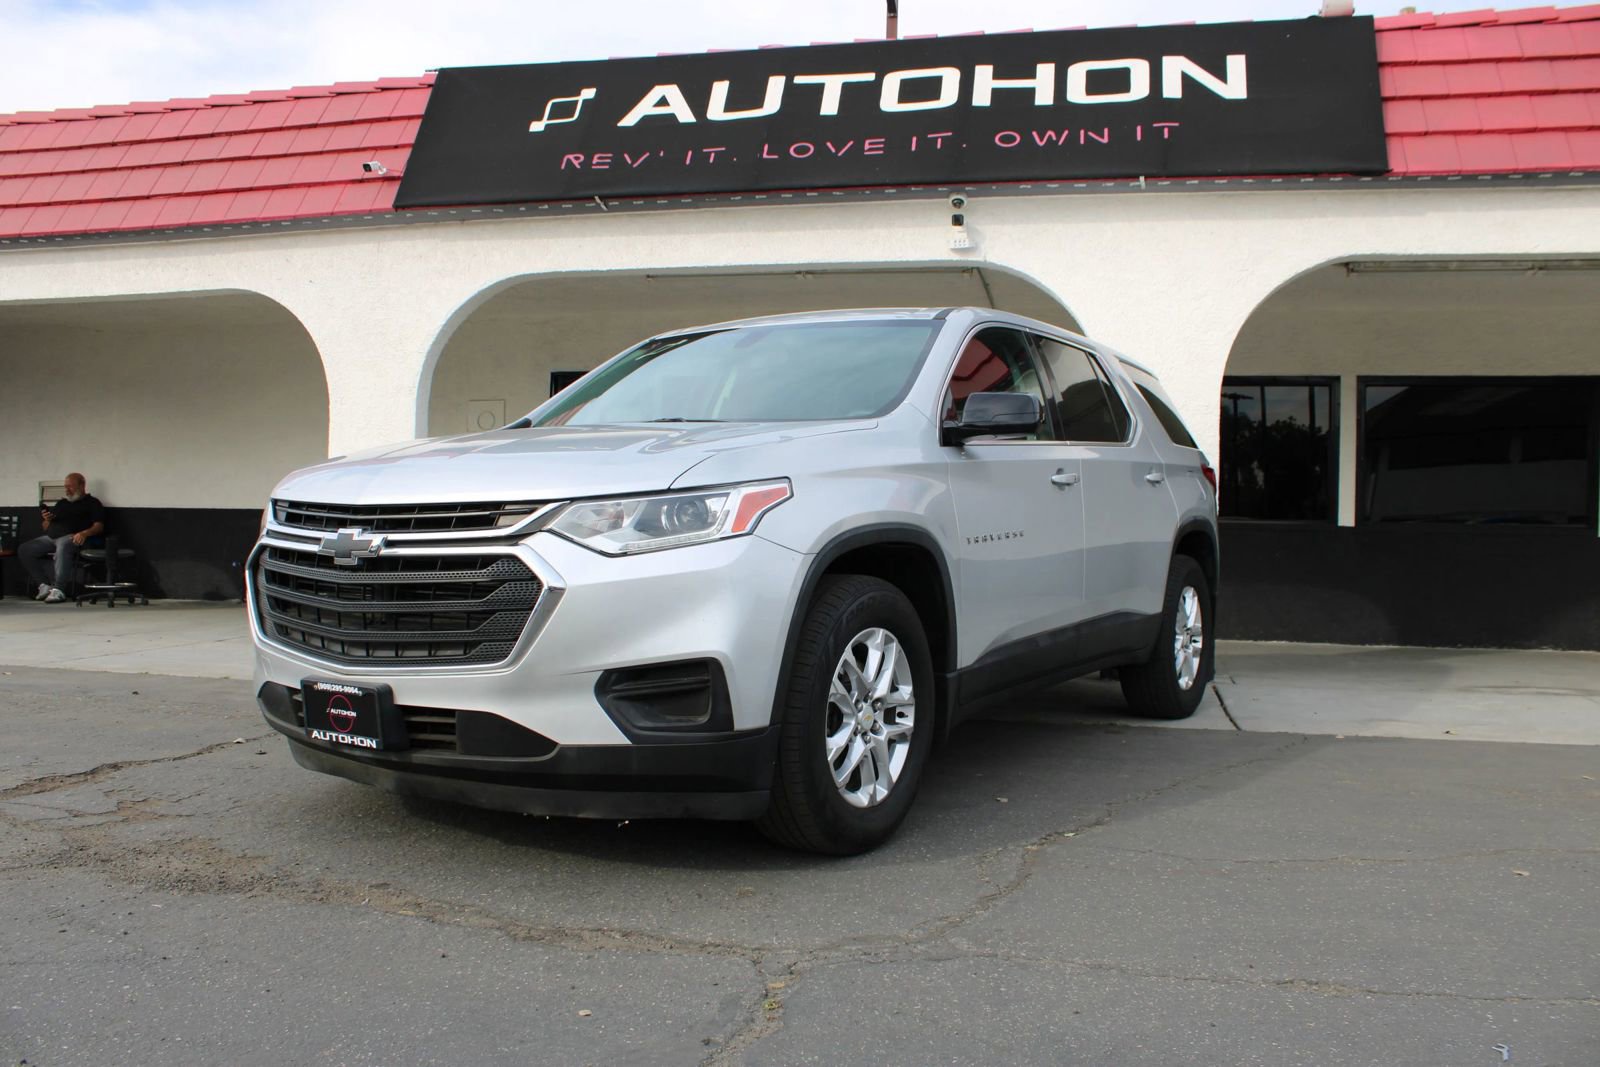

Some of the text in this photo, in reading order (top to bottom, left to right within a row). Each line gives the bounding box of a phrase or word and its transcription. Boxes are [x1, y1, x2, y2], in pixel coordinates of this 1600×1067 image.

[617, 54, 1248, 127] AUTOHON
[685, 147, 737, 165] IT.
[763, 138, 885, 159] LOVE
[911, 132, 967, 152] IT.
[994, 128, 1110, 148] OWN
[1136, 122, 1180, 141] IT
[330, 708, 357, 717] AUTOHON
[311, 730, 377, 749] AUTOHON
